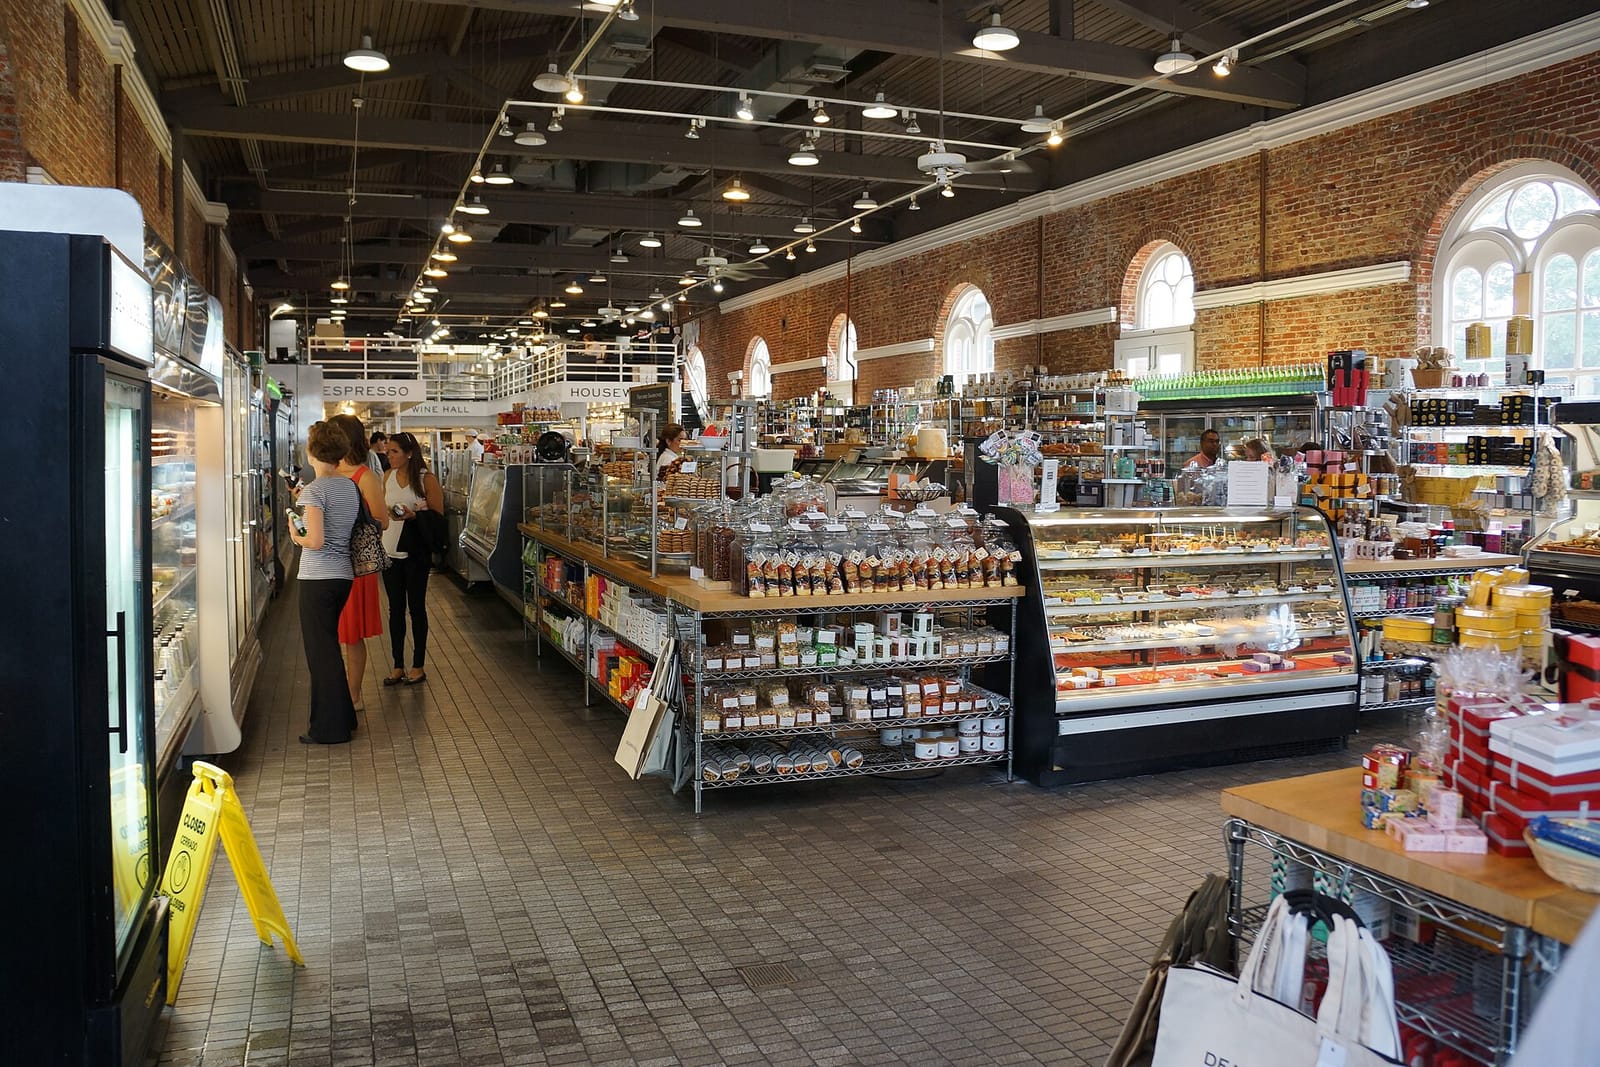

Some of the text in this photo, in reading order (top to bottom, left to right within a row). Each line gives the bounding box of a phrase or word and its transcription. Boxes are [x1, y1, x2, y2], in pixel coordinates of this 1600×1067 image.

[323, 386, 409, 397] ESPRESSO
[412, 406, 469, 414] WINE HALL
[183, 813, 206, 835] CLOSED
[1204, 1051, 1238, 1067] DE
